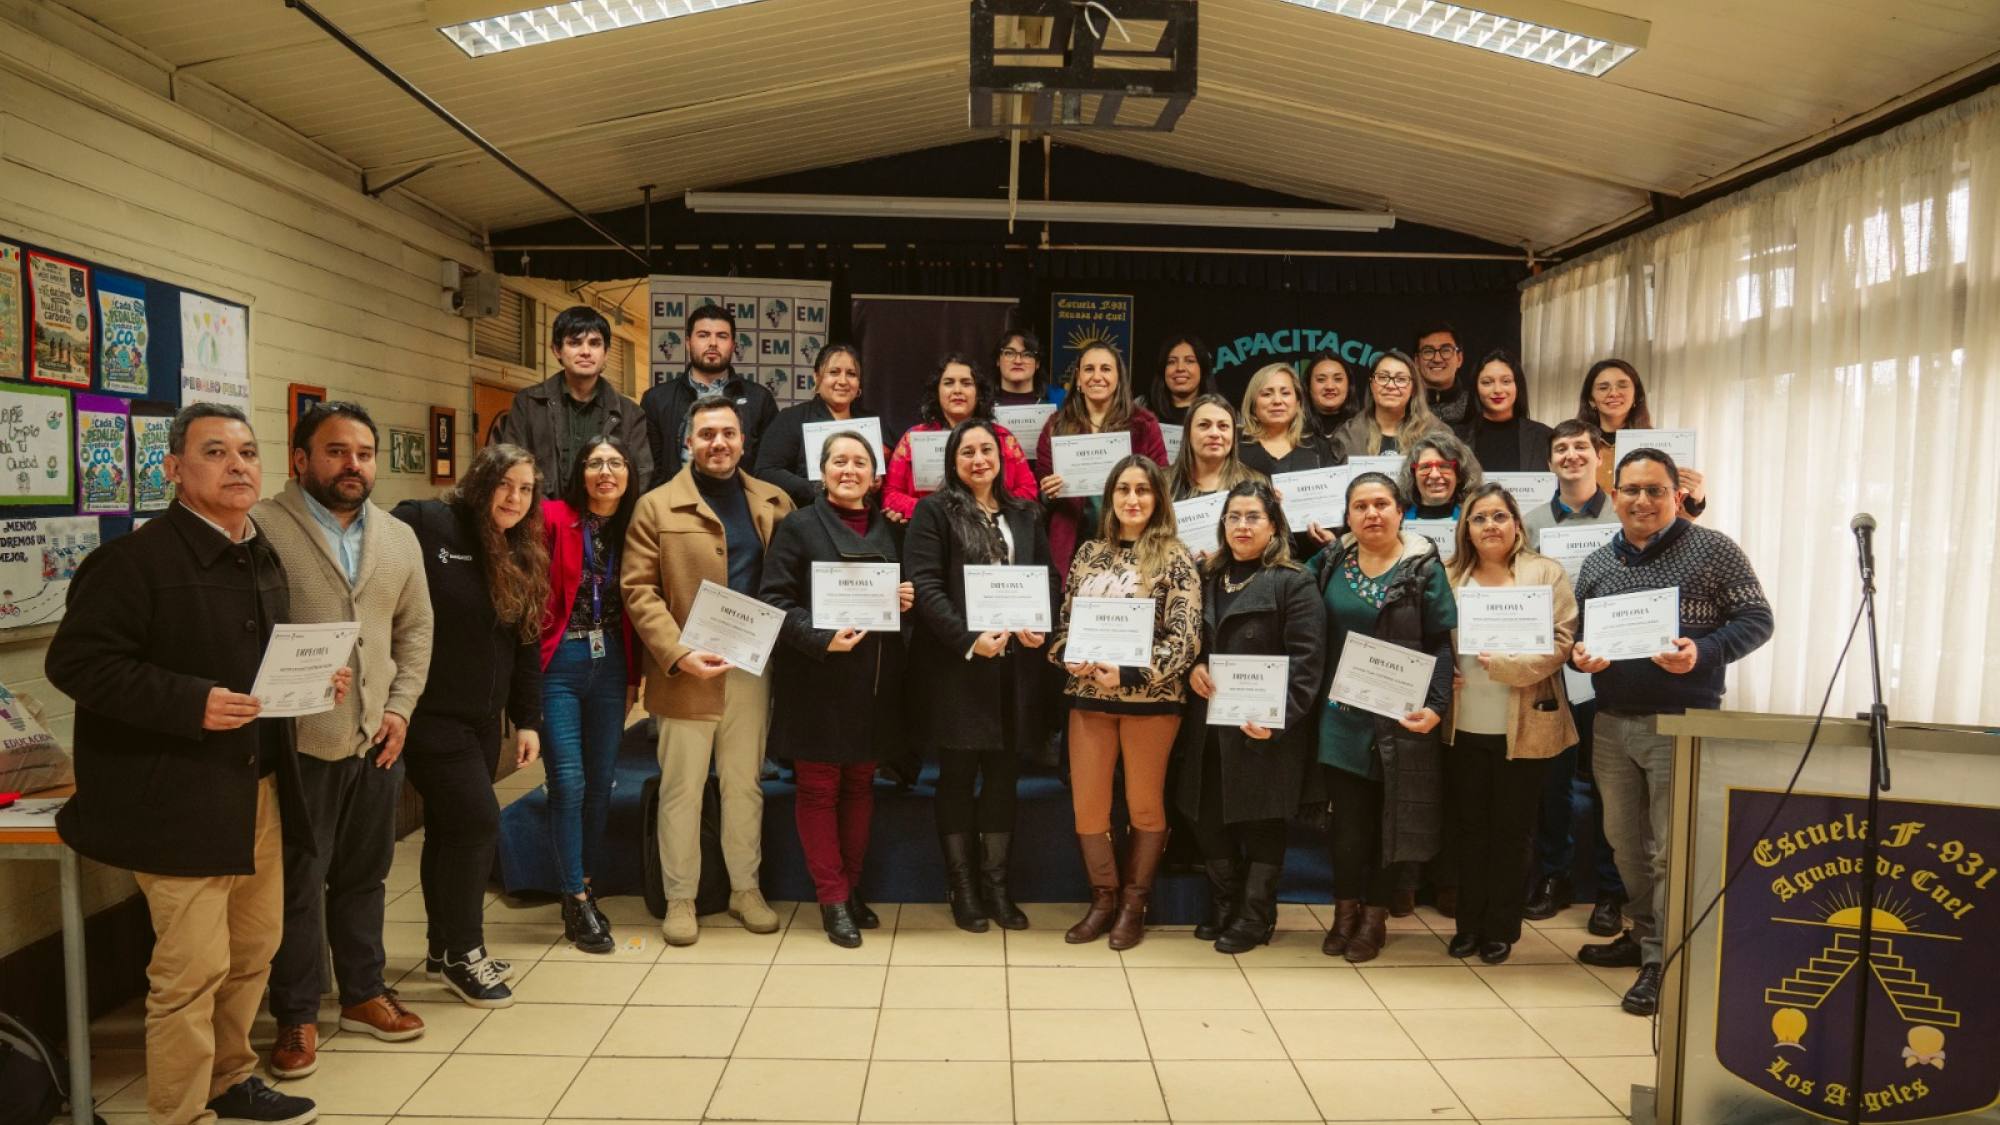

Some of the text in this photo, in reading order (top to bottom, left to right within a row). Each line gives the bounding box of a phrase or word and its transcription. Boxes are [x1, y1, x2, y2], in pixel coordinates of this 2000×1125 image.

[654, 301, 683, 318] EM
[726, 302, 755, 319] EM
[796, 306, 824, 323] EM
[761, 339, 790, 355] EM
[1075, 448, 1107, 457] DIPLOMA
[4, 520, 37, 533] MENOS
[36, 535, 46, 545] UN
[838, 579, 874, 587] DIPLOMA
[1486, 603, 1524, 611] DIPLOMA
[1611, 607, 1650, 618] DIPLOMA
[720, 605, 755, 624] DIPLOMA
[1095, 614, 1129, 622] DIPLOMA
[296, 646, 329, 657] DIPLOMA
[1369, 655, 1404, 673] DIPLOMA
[1232, 673, 1264, 681] DIPLOMA
[1752, 813, 1870, 867] Escuela
[1876, 855, 1905, 880] de
[1910, 869, 1975, 920] Cuel
[1765, 1055, 1930, 1113] Los Ageles
